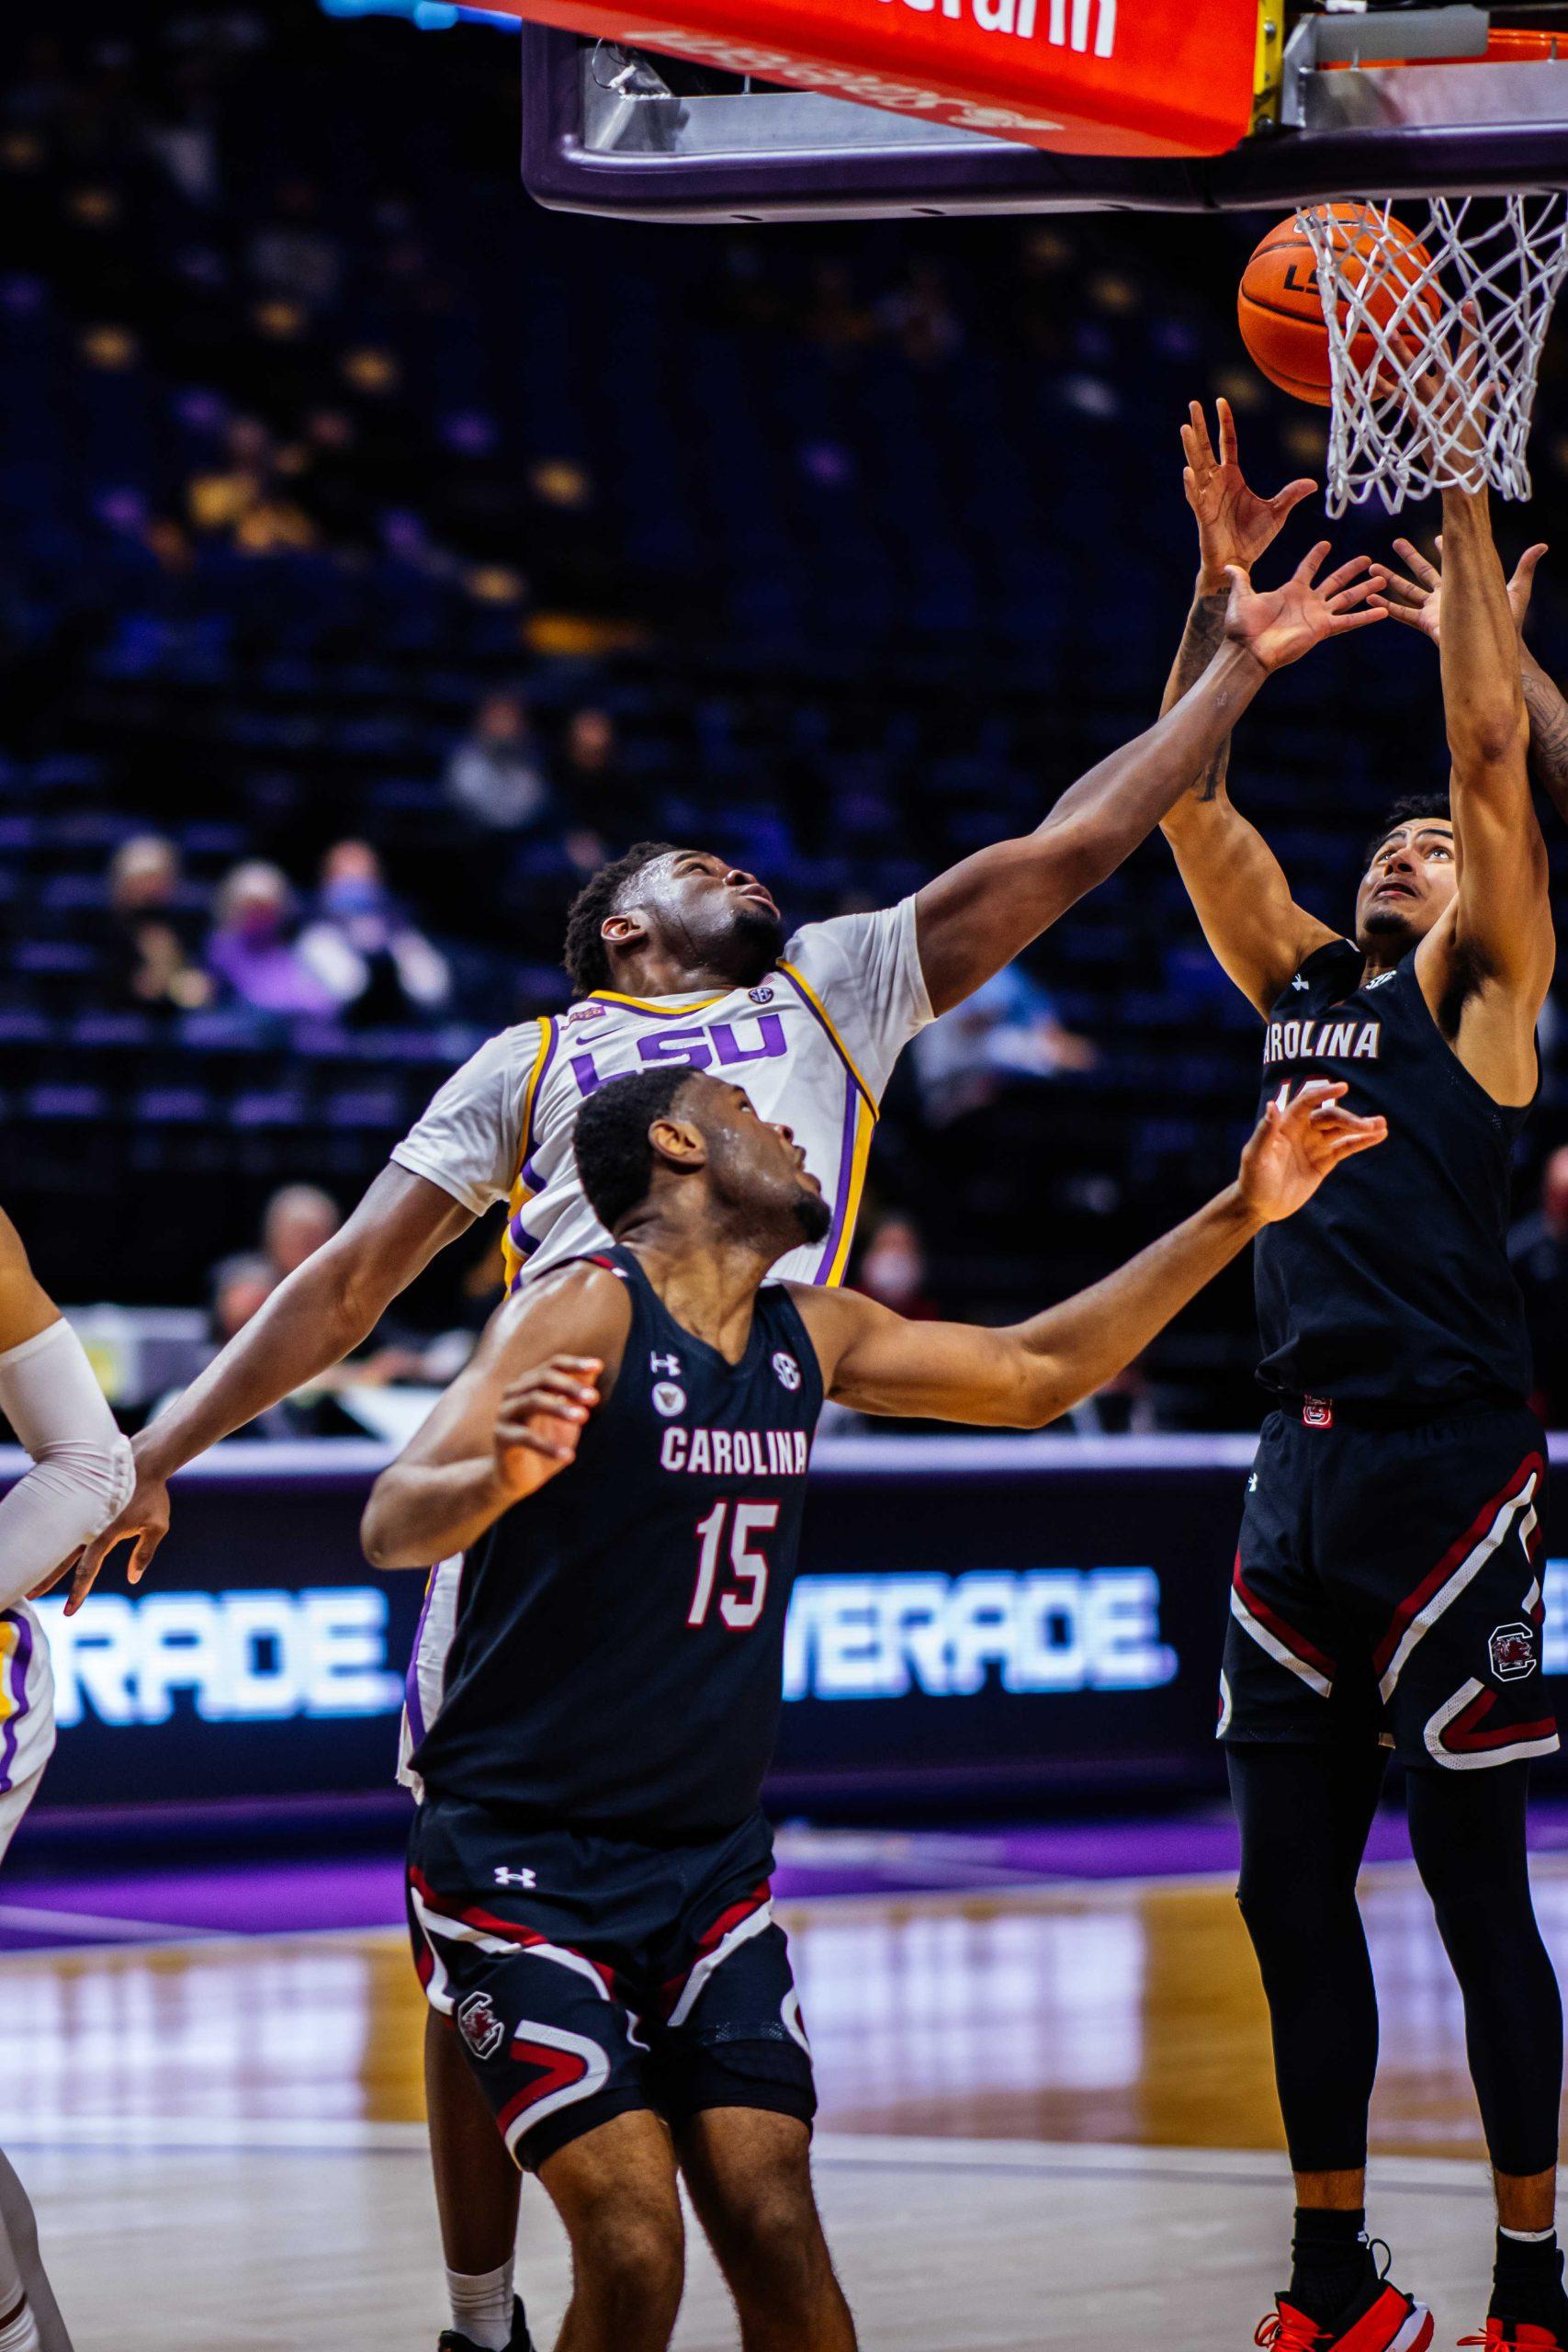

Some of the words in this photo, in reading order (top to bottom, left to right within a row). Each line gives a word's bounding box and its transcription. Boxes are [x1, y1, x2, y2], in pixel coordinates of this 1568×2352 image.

[749, 988, 773, 1004] SEC
[570, 1013, 787, 1097] LSU
[660, 1426, 808, 1476] CAROLINA
[686, 1498, 782, 1632] 15
